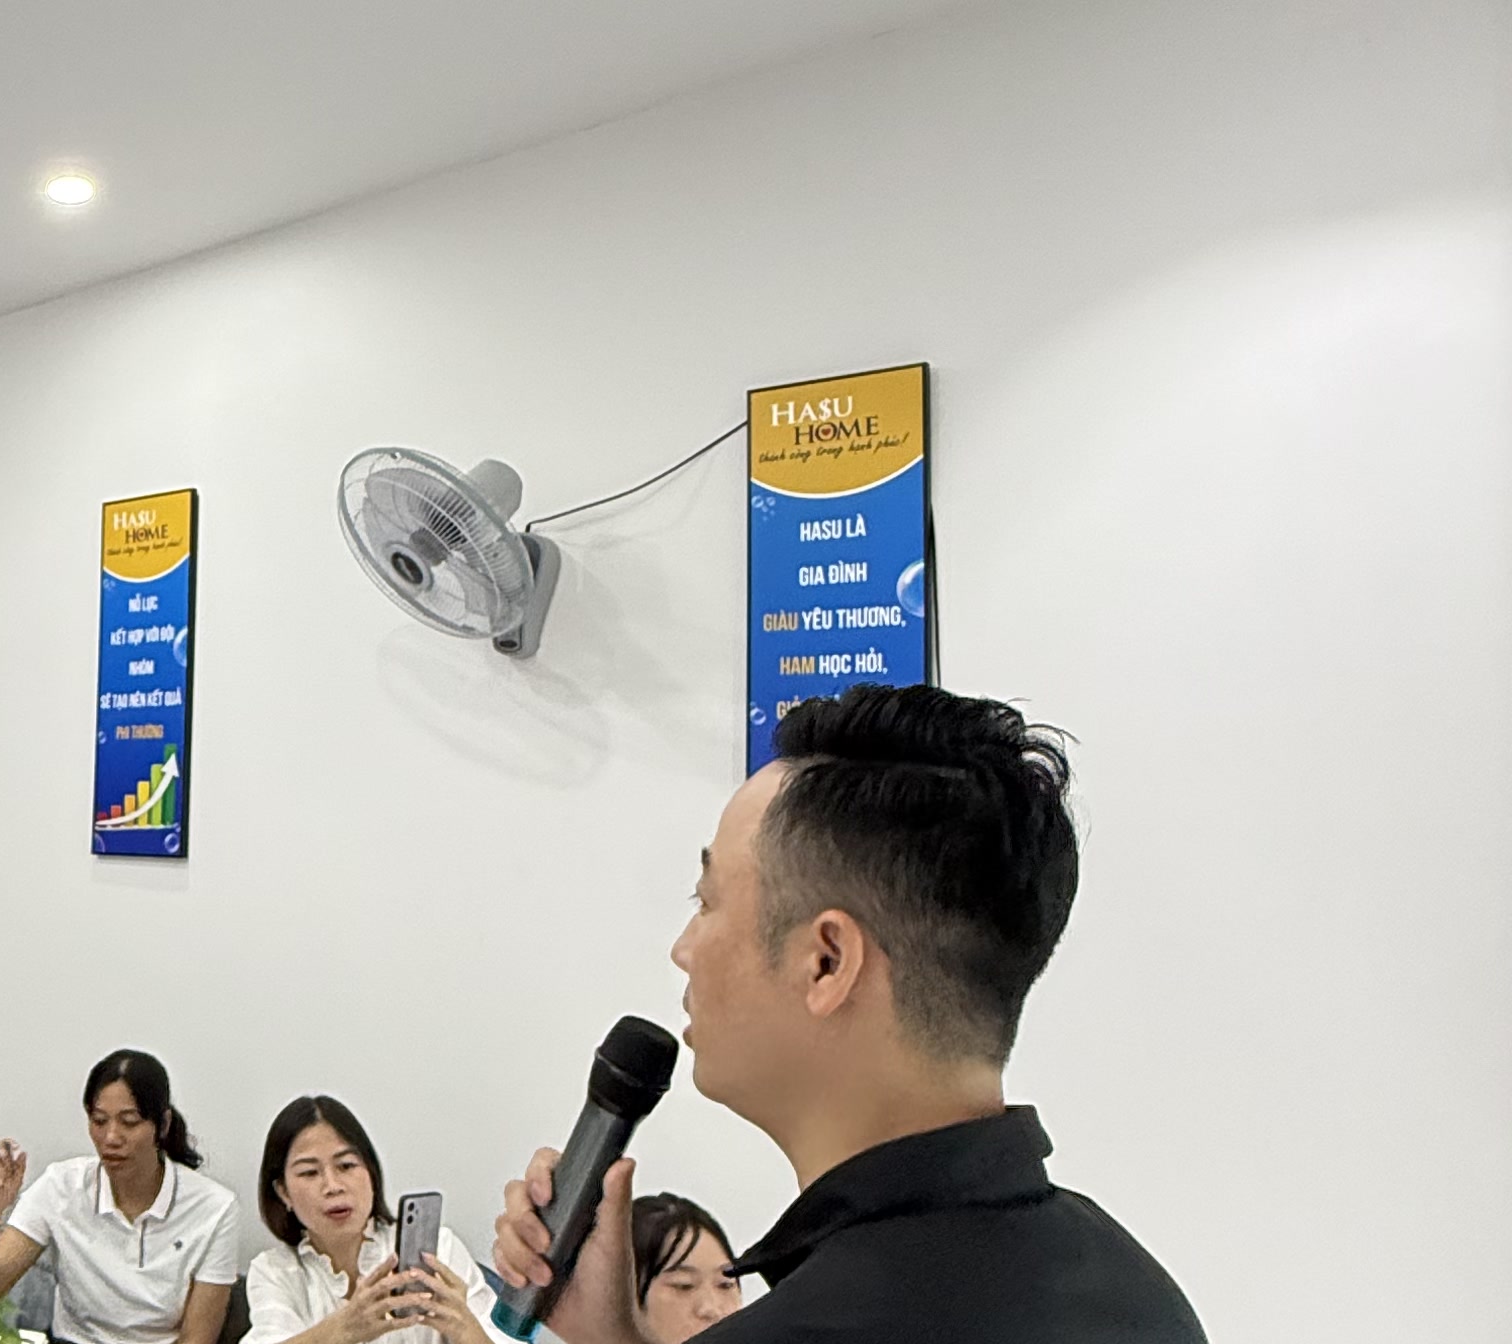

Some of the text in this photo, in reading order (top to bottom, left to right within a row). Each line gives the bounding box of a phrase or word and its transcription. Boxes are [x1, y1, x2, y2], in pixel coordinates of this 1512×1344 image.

[794, 415, 880, 446] HOME
[125, 524, 169, 545] HOME
[799, 512, 867, 543] HASU LÀ
[798, 559, 868, 587] GIA ĐÌNH
[762, 605, 907, 633] GIÀU YÊU THƯƠNG,
[779, 646, 889, 679] HAM HỌC HỎI,
